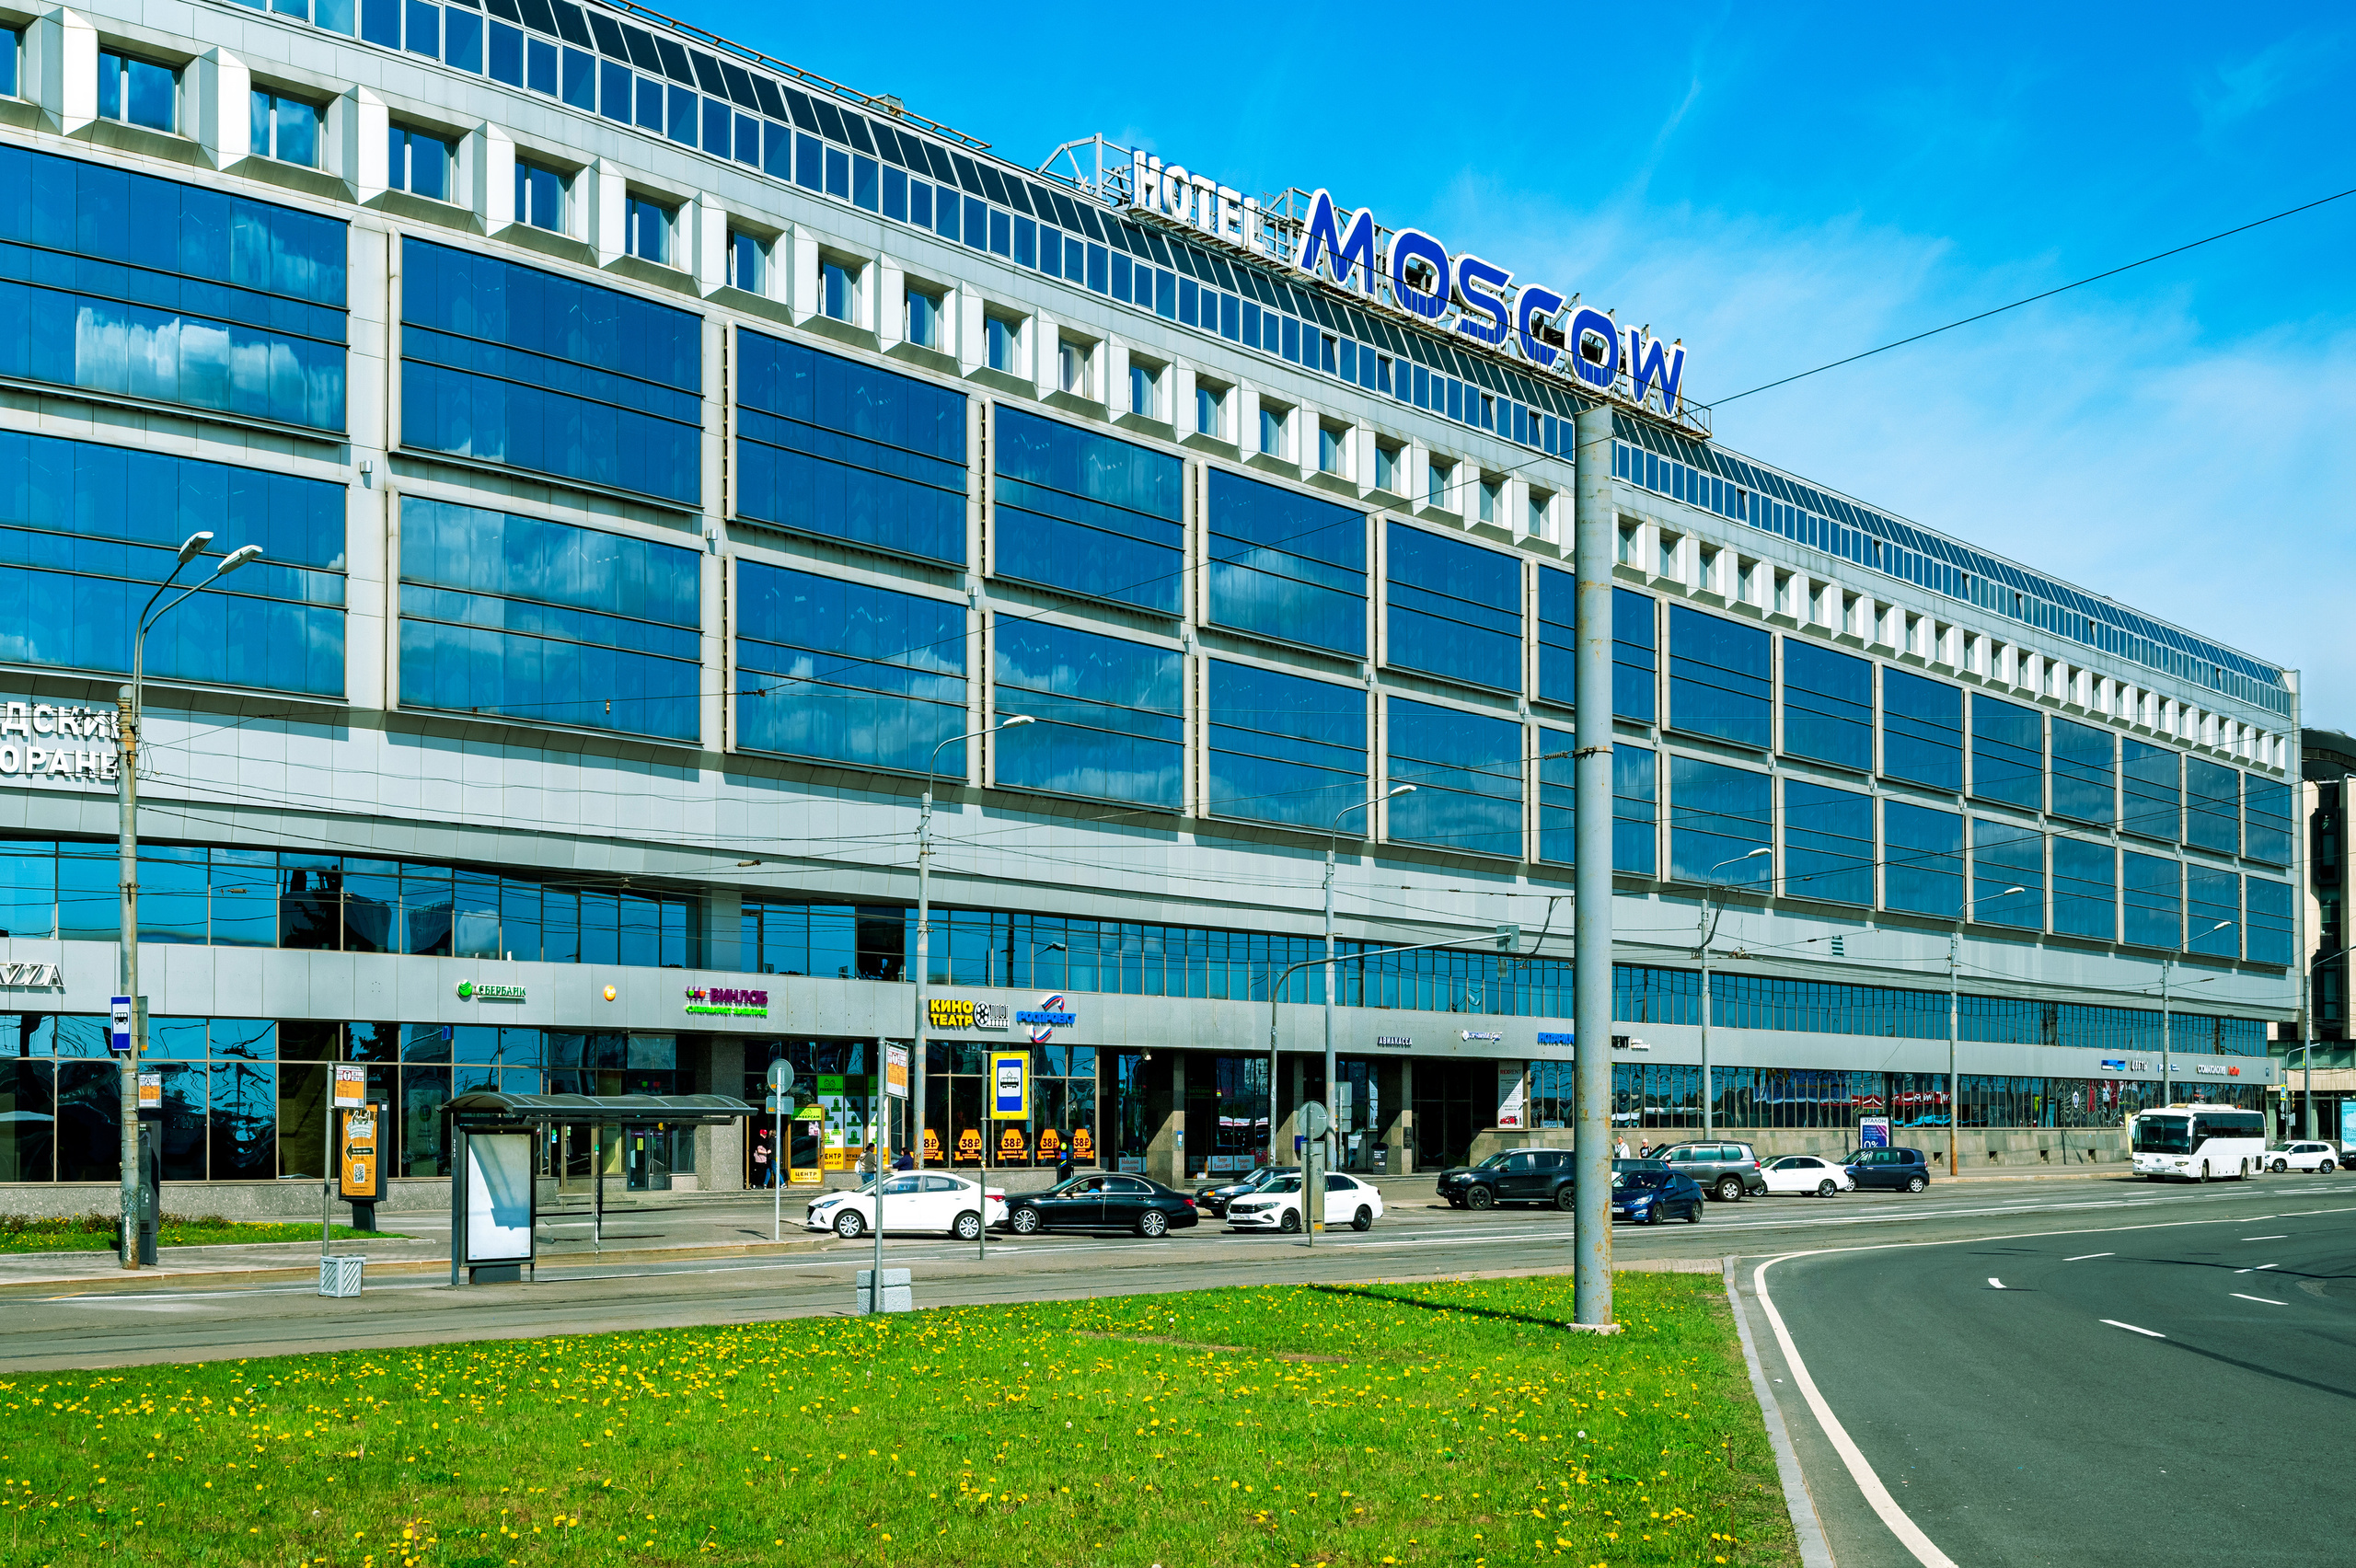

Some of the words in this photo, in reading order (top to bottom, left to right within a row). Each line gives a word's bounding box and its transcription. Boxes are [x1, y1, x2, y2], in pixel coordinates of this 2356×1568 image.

[1131, 146, 1265, 256] HOTEL
[1294, 188, 1687, 418] MOSCOW
[477, 985, 526, 997] СБЕРБАНК
[930, 999, 974, 1014] КИНО
[930, 1013, 974, 1027] ТЕАТР
[1016, 1010, 1077, 1024] РОСПРОЕКТ
[1378, 1036, 1413, 1045] АВИАКАССА
